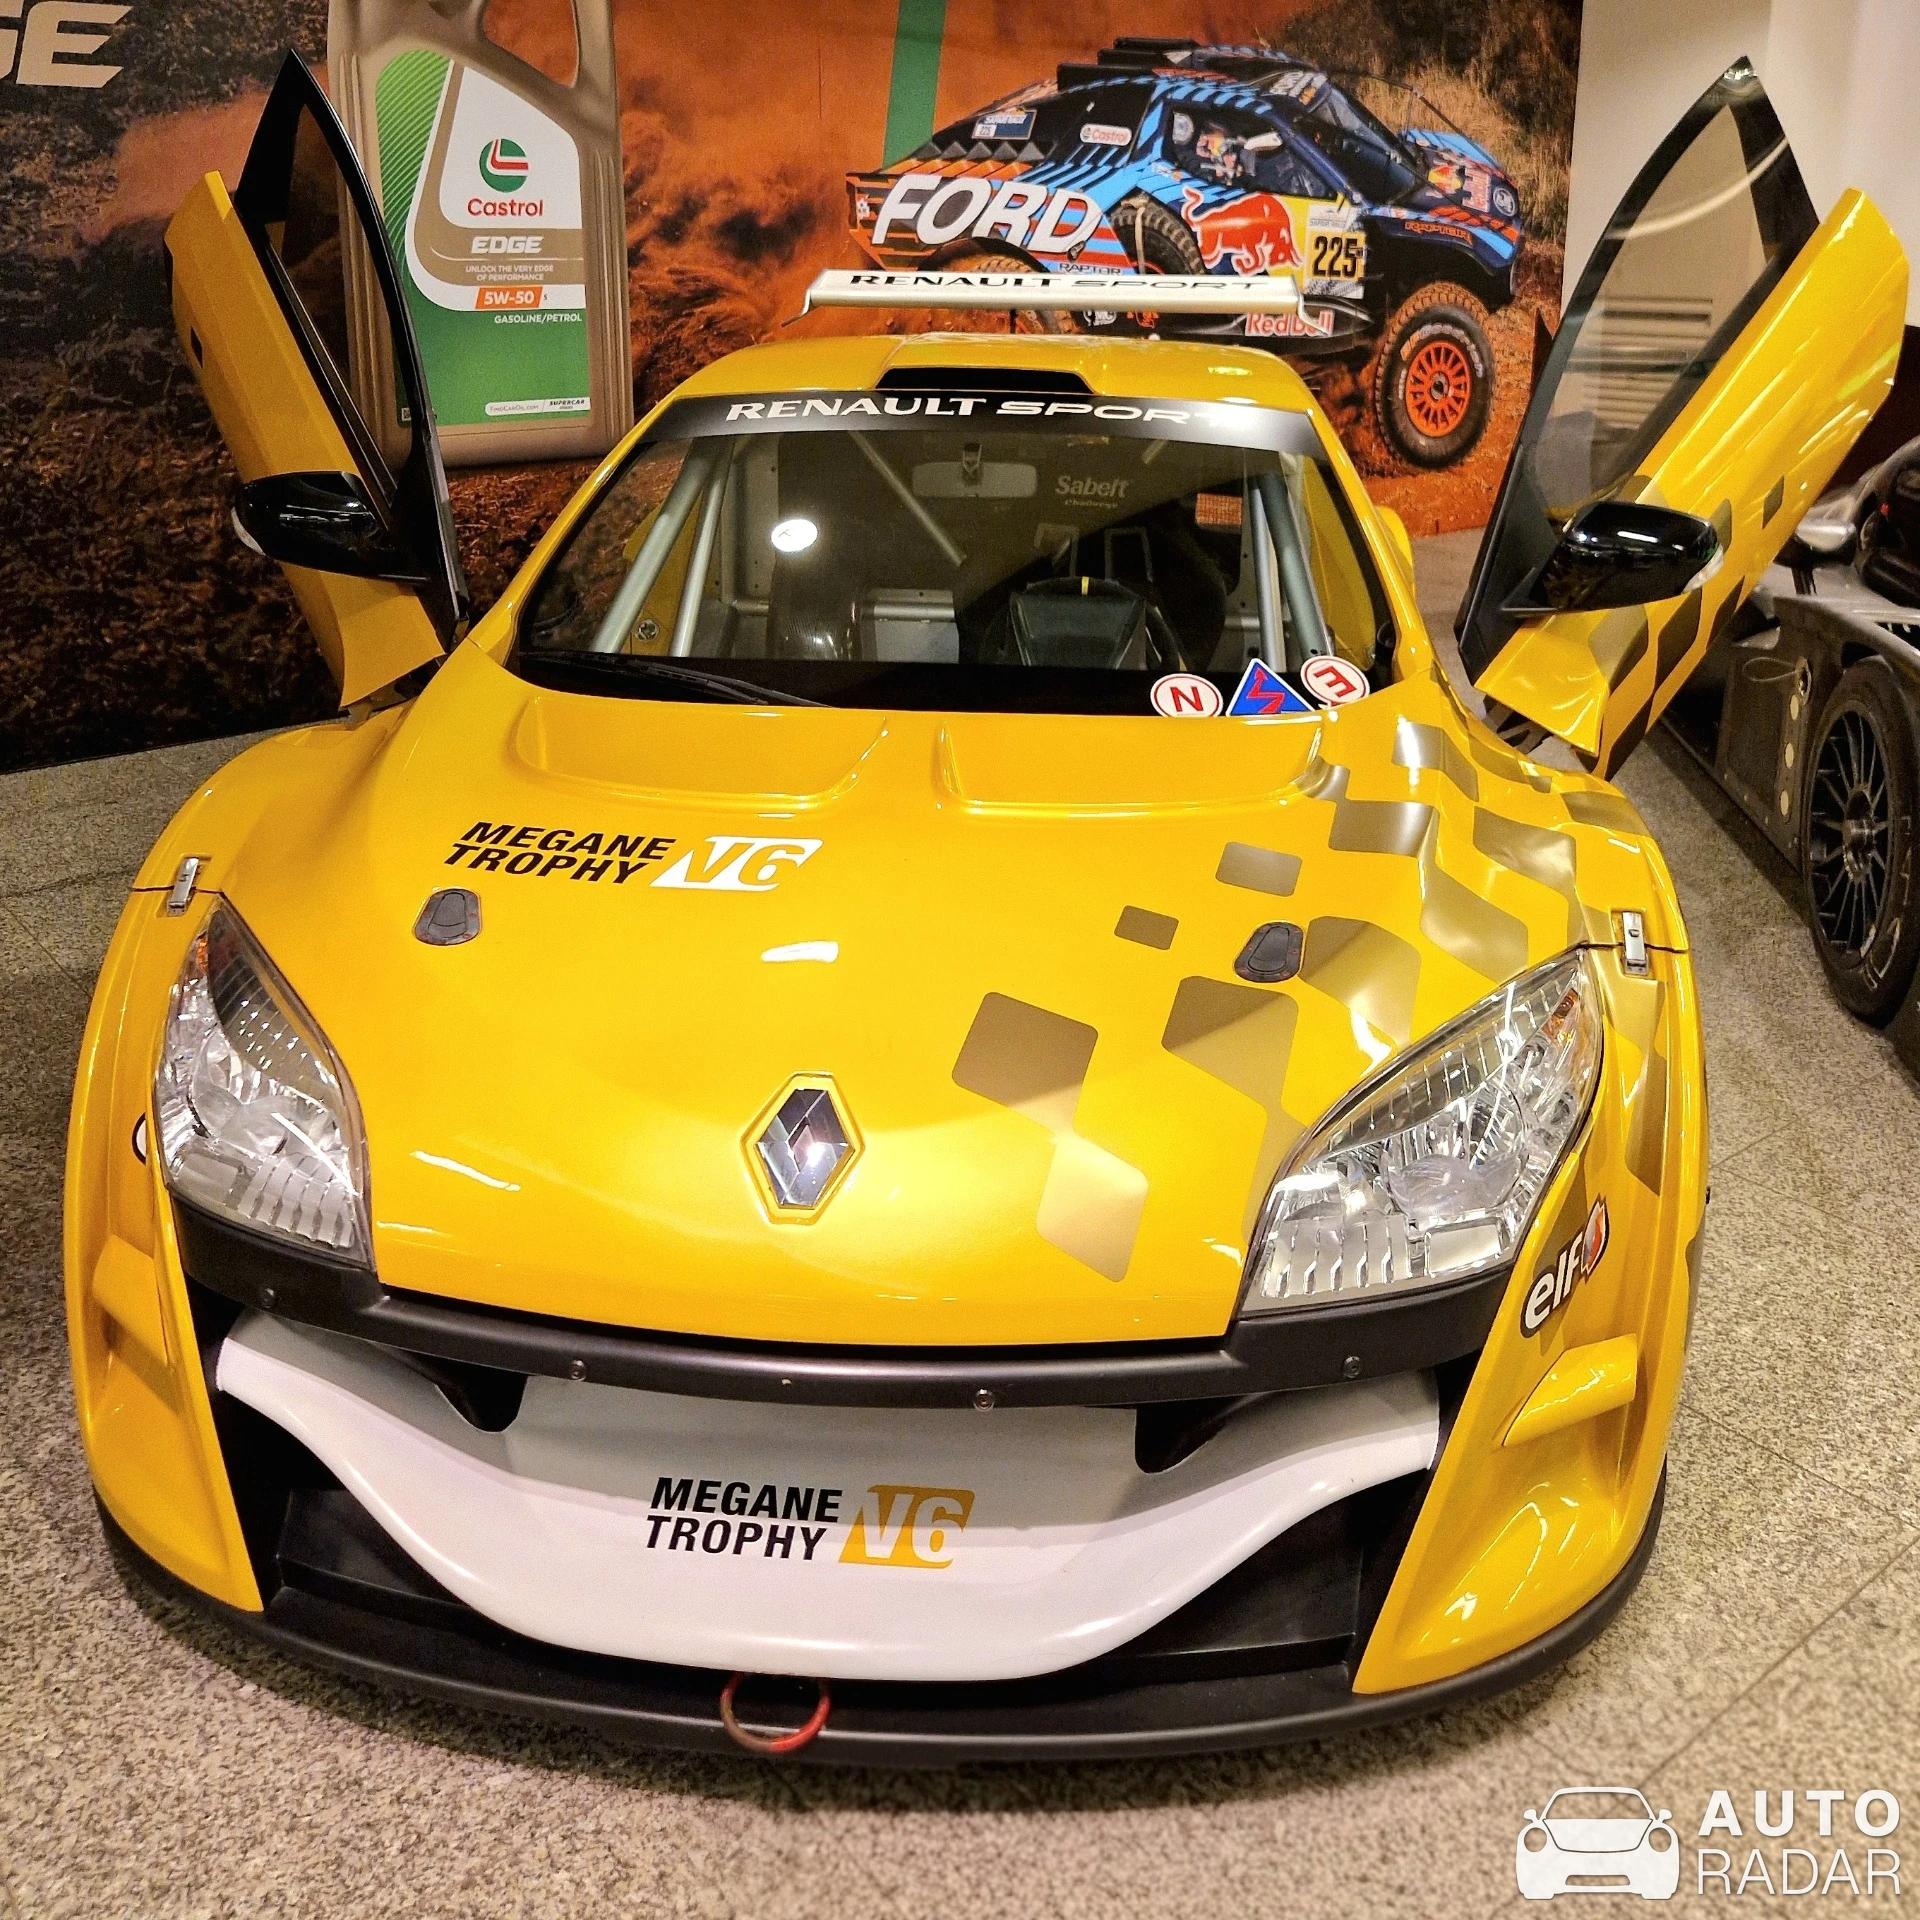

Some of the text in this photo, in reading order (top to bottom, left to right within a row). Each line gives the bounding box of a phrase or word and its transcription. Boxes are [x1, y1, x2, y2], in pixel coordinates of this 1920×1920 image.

[0, 0, 134, 88] E
[467, 198, 544, 217] Castrol
[871, 174, 1103, 253] FORD
[471, 236, 544, 254] EDGE
[1312, 235, 1359, 278] 225
[465, 265, 496, 273] UNLOCK
[498, 265, 512, 273] THE
[488, 273, 545, 281] PERFORMANCE
[1059, 263, 1122, 275] RAPTOR
[850, 275, 1269, 290] RENAULT SPORT
[483, 291, 535, 305] 5W-50
[494, 313, 582, 324] GASOLINE/PETROL
[1246, 311, 1290, 336] Red
[726, 397, 986, 422] RENAULT
[1055, 475, 1129, 498] Sabelt
[1313, 665, 1357, 698] E
[1169, 685, 1204, 712] N
[443, 843, 649, 885] TROPHY
[459, 821, 823, 891] MEGANE V6
[1524, 1230, 1585, 1330] elf
[650, 1476, 976, 1569] MEGANE V6
[646, 1514, 828, 1561] TROPHY
